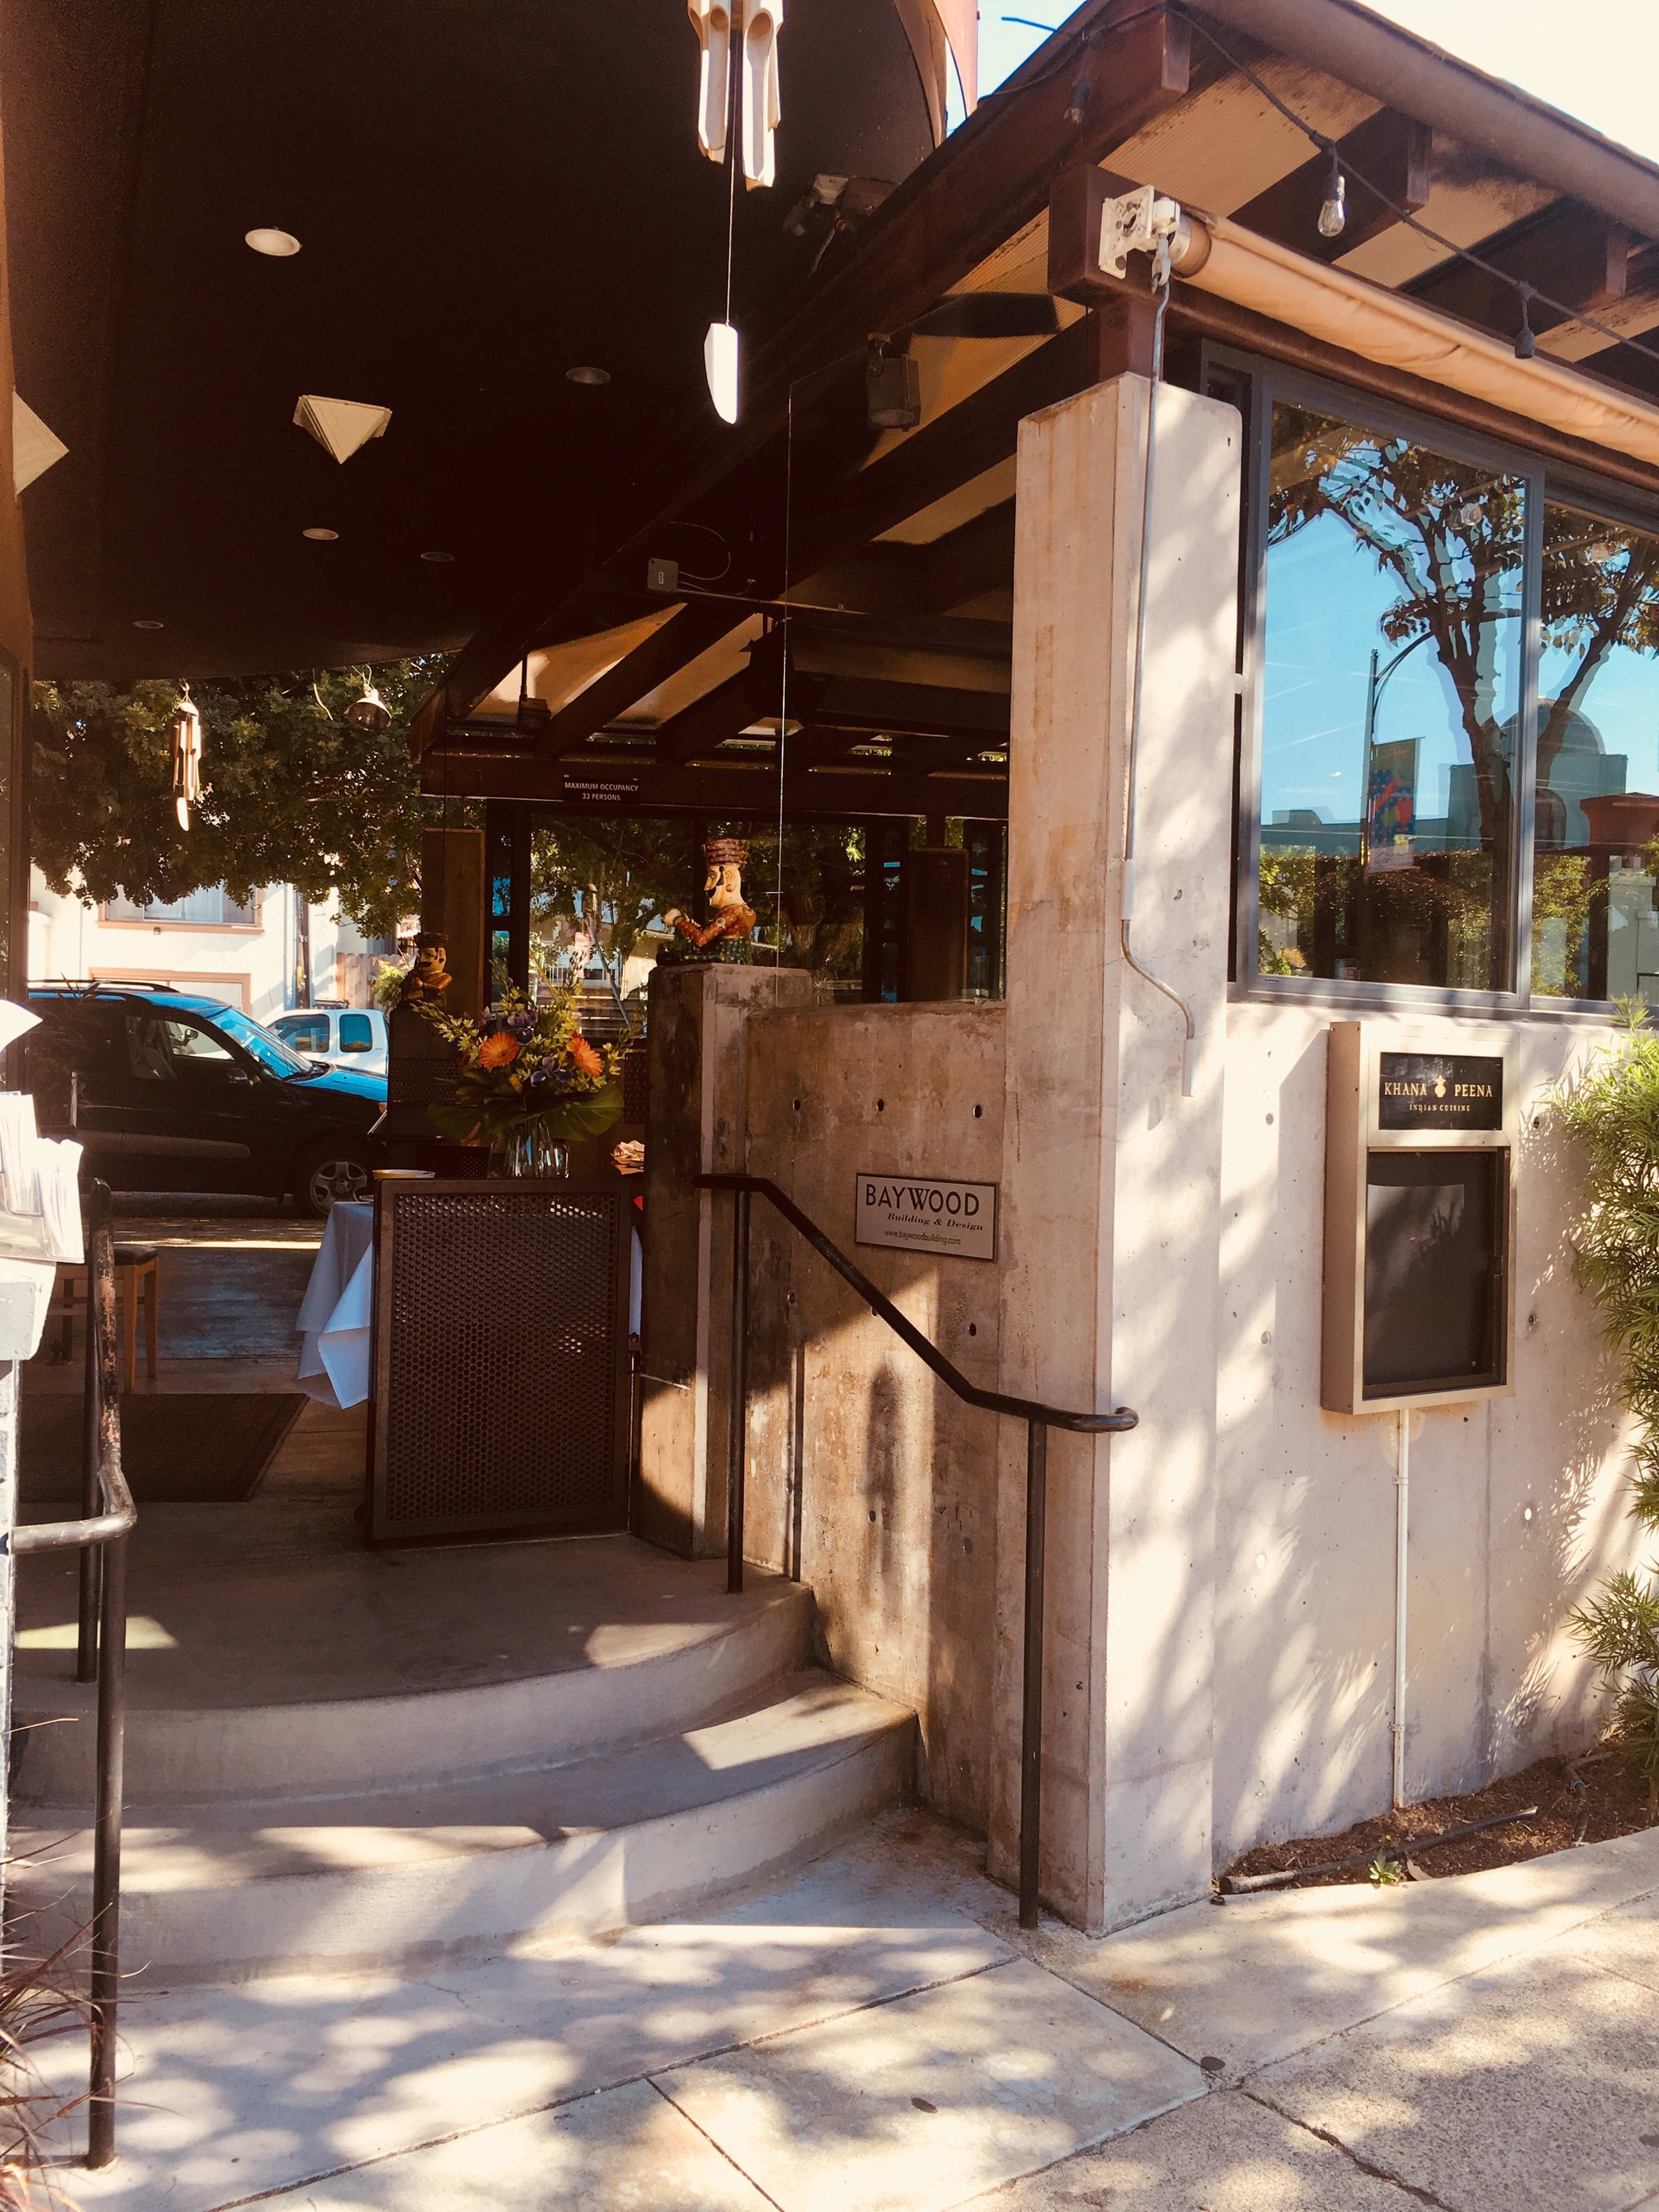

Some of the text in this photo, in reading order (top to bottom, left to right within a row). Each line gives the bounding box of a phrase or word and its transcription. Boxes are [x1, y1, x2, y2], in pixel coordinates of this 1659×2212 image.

[1384, 1082, 1493, 1097] KHANA PEENA
[865, 1183, 979, 1216] BAYWOOD
[887, 1212, 930, 1226] Building
[947, 1219, 983, 1231] Design
[884, 1230, 961, 1246] www.baywoodbuilding.com
